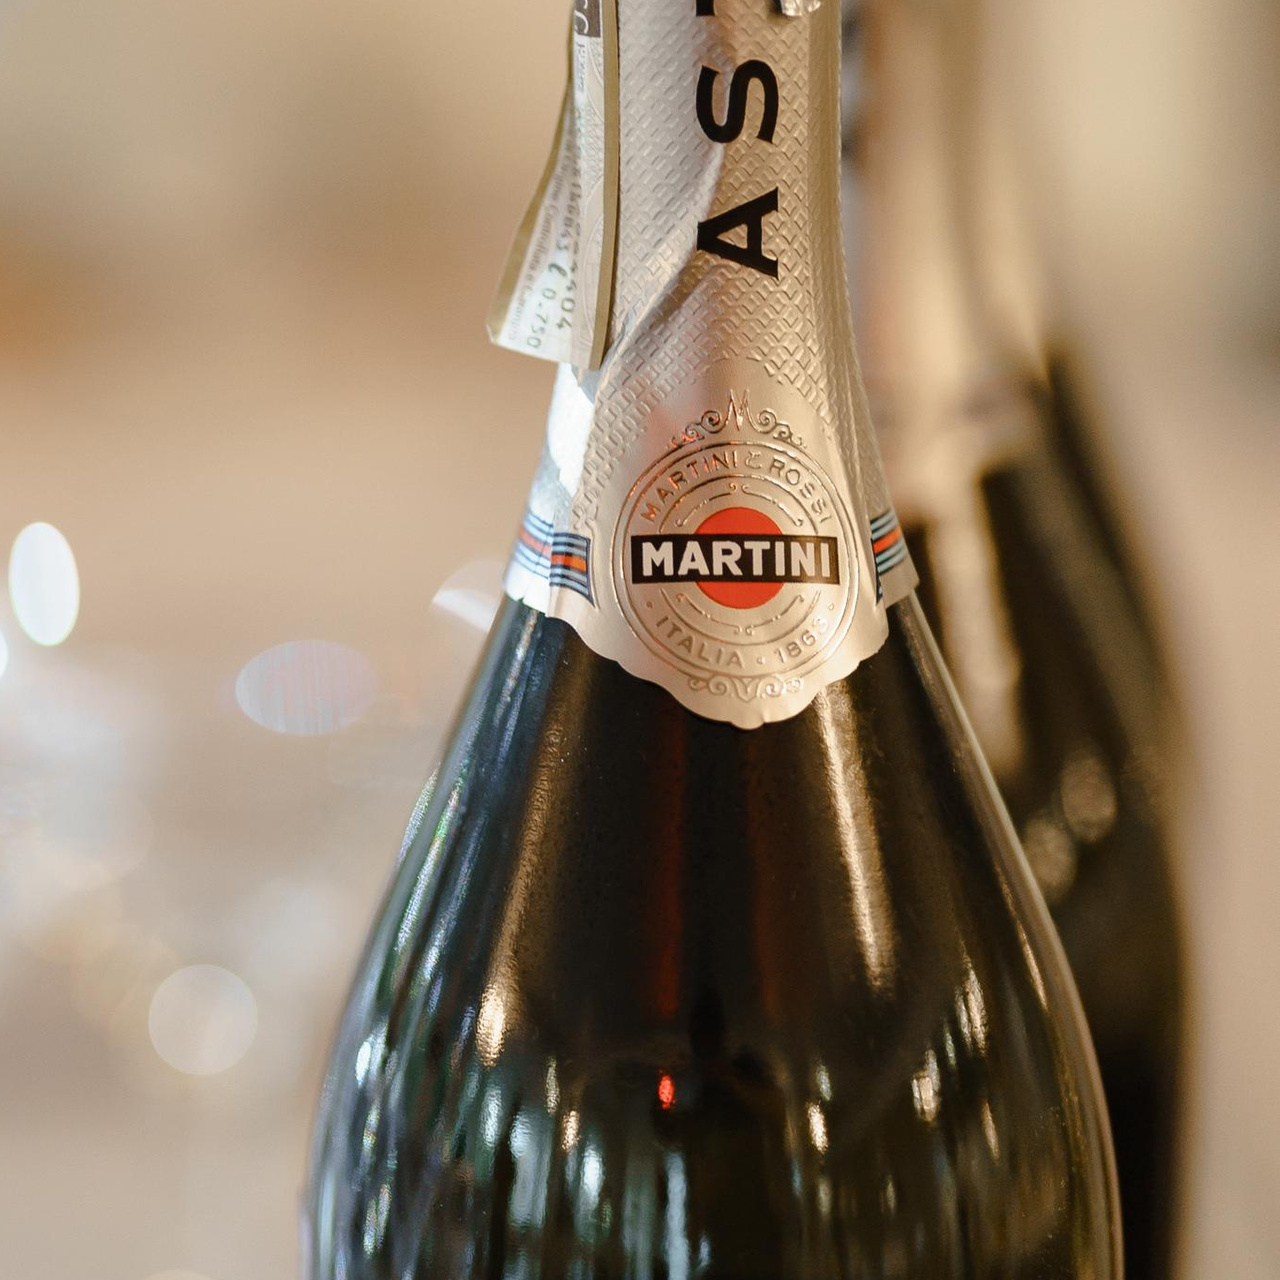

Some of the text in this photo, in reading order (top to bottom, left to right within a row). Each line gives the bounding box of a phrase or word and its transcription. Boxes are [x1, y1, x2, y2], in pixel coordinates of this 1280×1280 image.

[639, 450, 738, 524] MARTINI
[769, 458, 832, 523] ROSSI
[640, 540, 831, 579] MARTINI
[655, 615, 829, 669] ITALIA 1863
